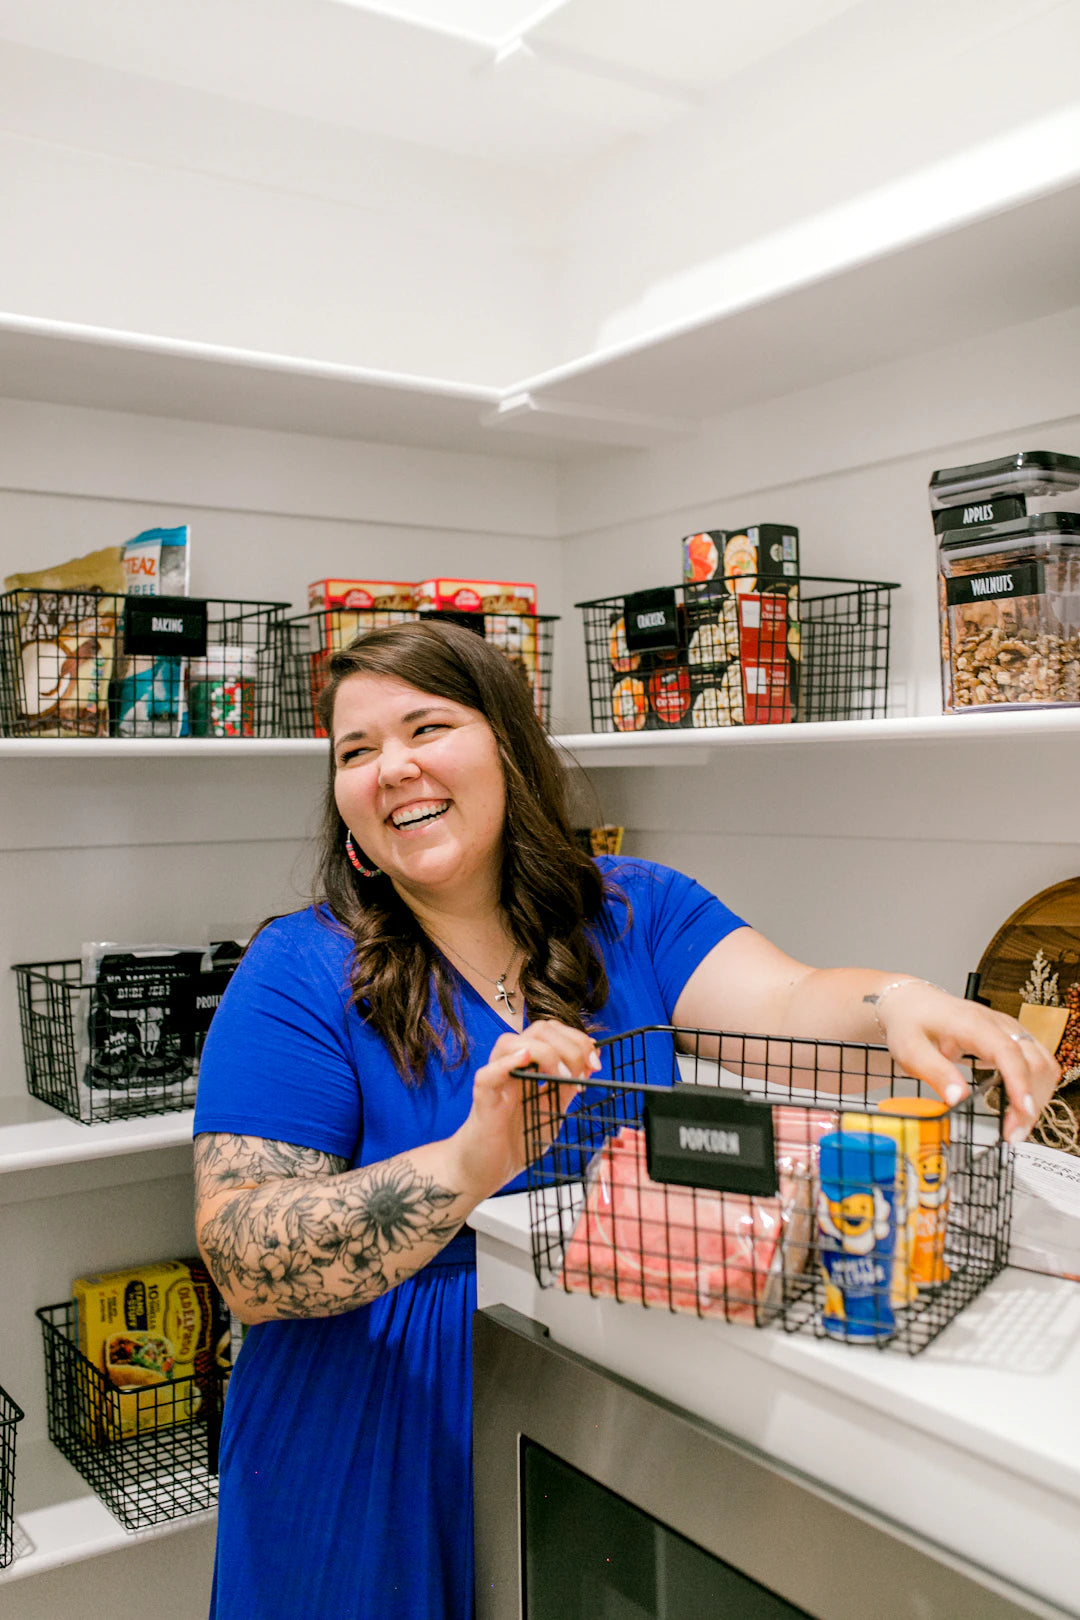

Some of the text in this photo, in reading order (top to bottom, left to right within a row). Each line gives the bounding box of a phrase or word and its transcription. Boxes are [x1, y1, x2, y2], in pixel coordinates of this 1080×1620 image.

[963, 504, 993, 524] APPLES
[971, 575, 1014, 596] WALNUTS
[152, 616, 183, 633] BAKING
[679, 1125, 740, 1157] POPCORN
[148, 1284, 160, 1300] 10
